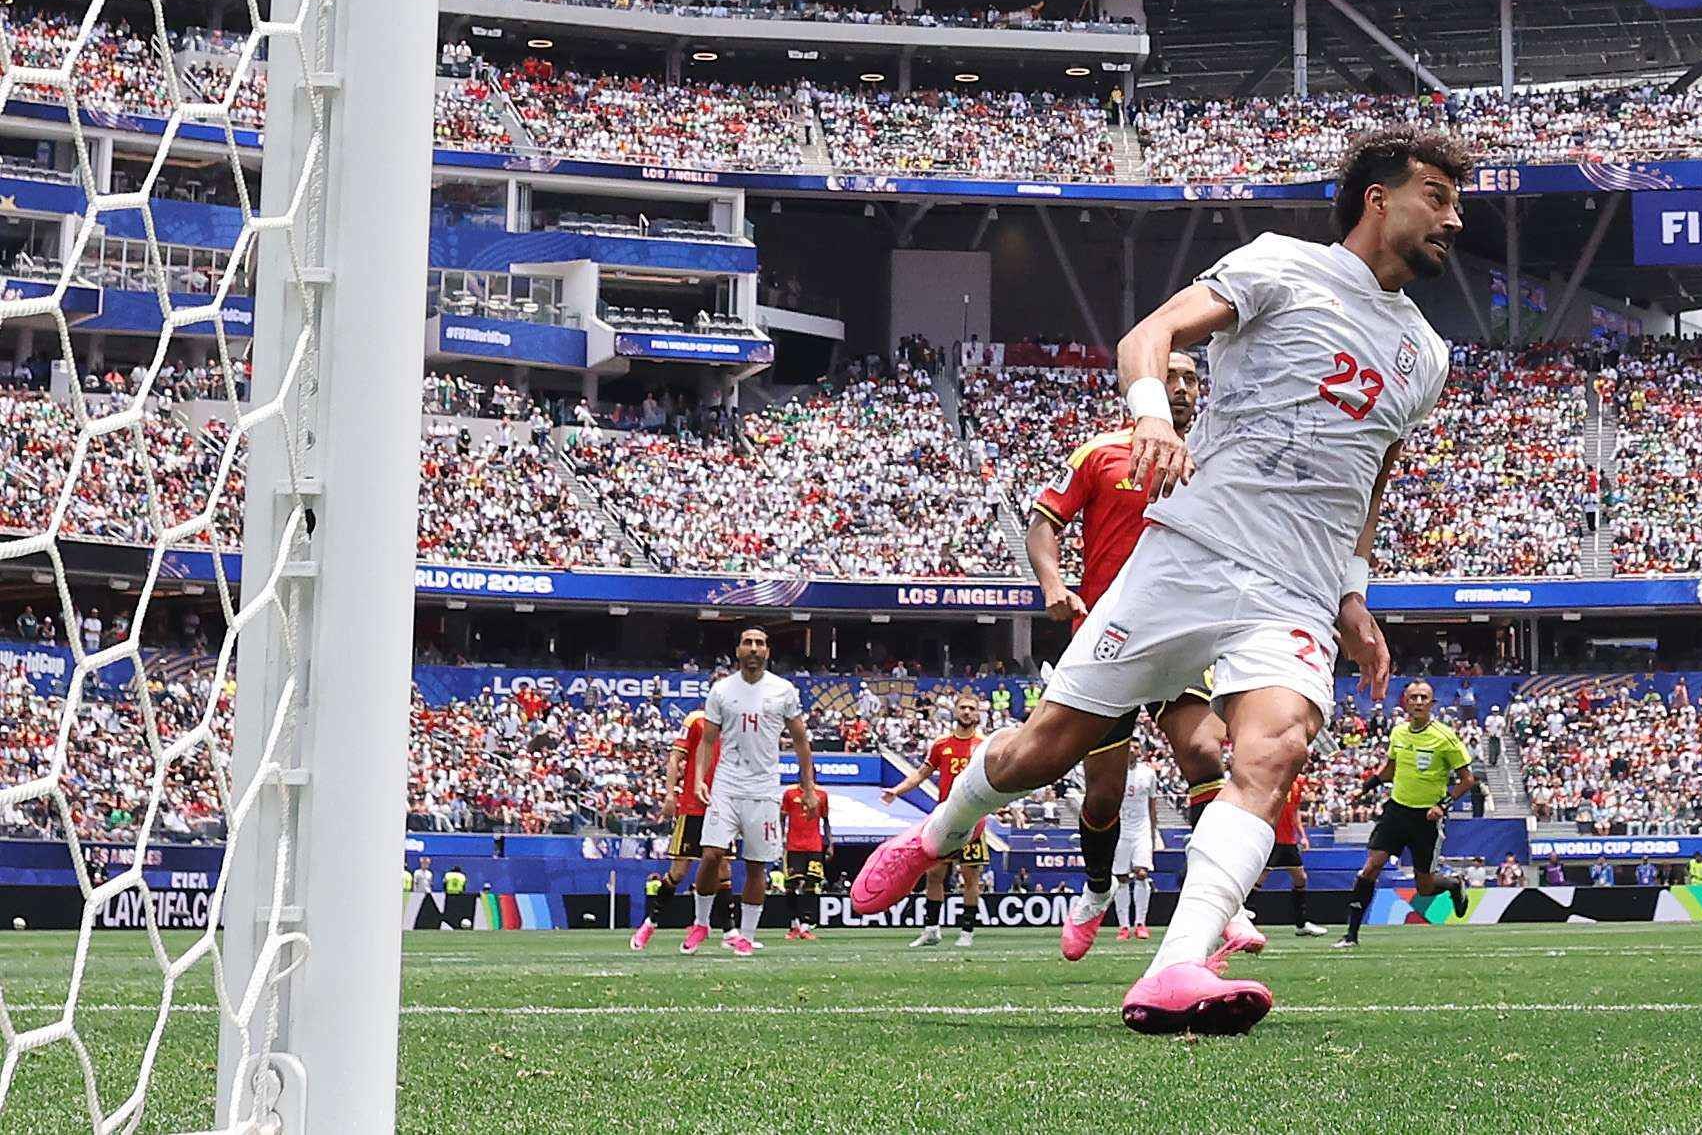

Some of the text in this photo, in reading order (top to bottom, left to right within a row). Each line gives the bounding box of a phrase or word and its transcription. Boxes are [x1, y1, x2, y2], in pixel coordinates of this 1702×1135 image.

[415, 569, 553, 594] RLD CUP 2026
[898, 587, 1034, 606] LOS ANGELES
[494, 675, 554, 696] LOS
[741, 712, 758, 733] 14
[950, 757, 968, 774] 23
[763, 821, 777, 842] 14
[962, 842, 981, 861] 23
[1553, 842, 1602, 854] WORLD
[1603, 841, 1631, 853] CUP
[1631, 841, 1680, 854] 2026
[1036, 855, 1064, 867] LOS
